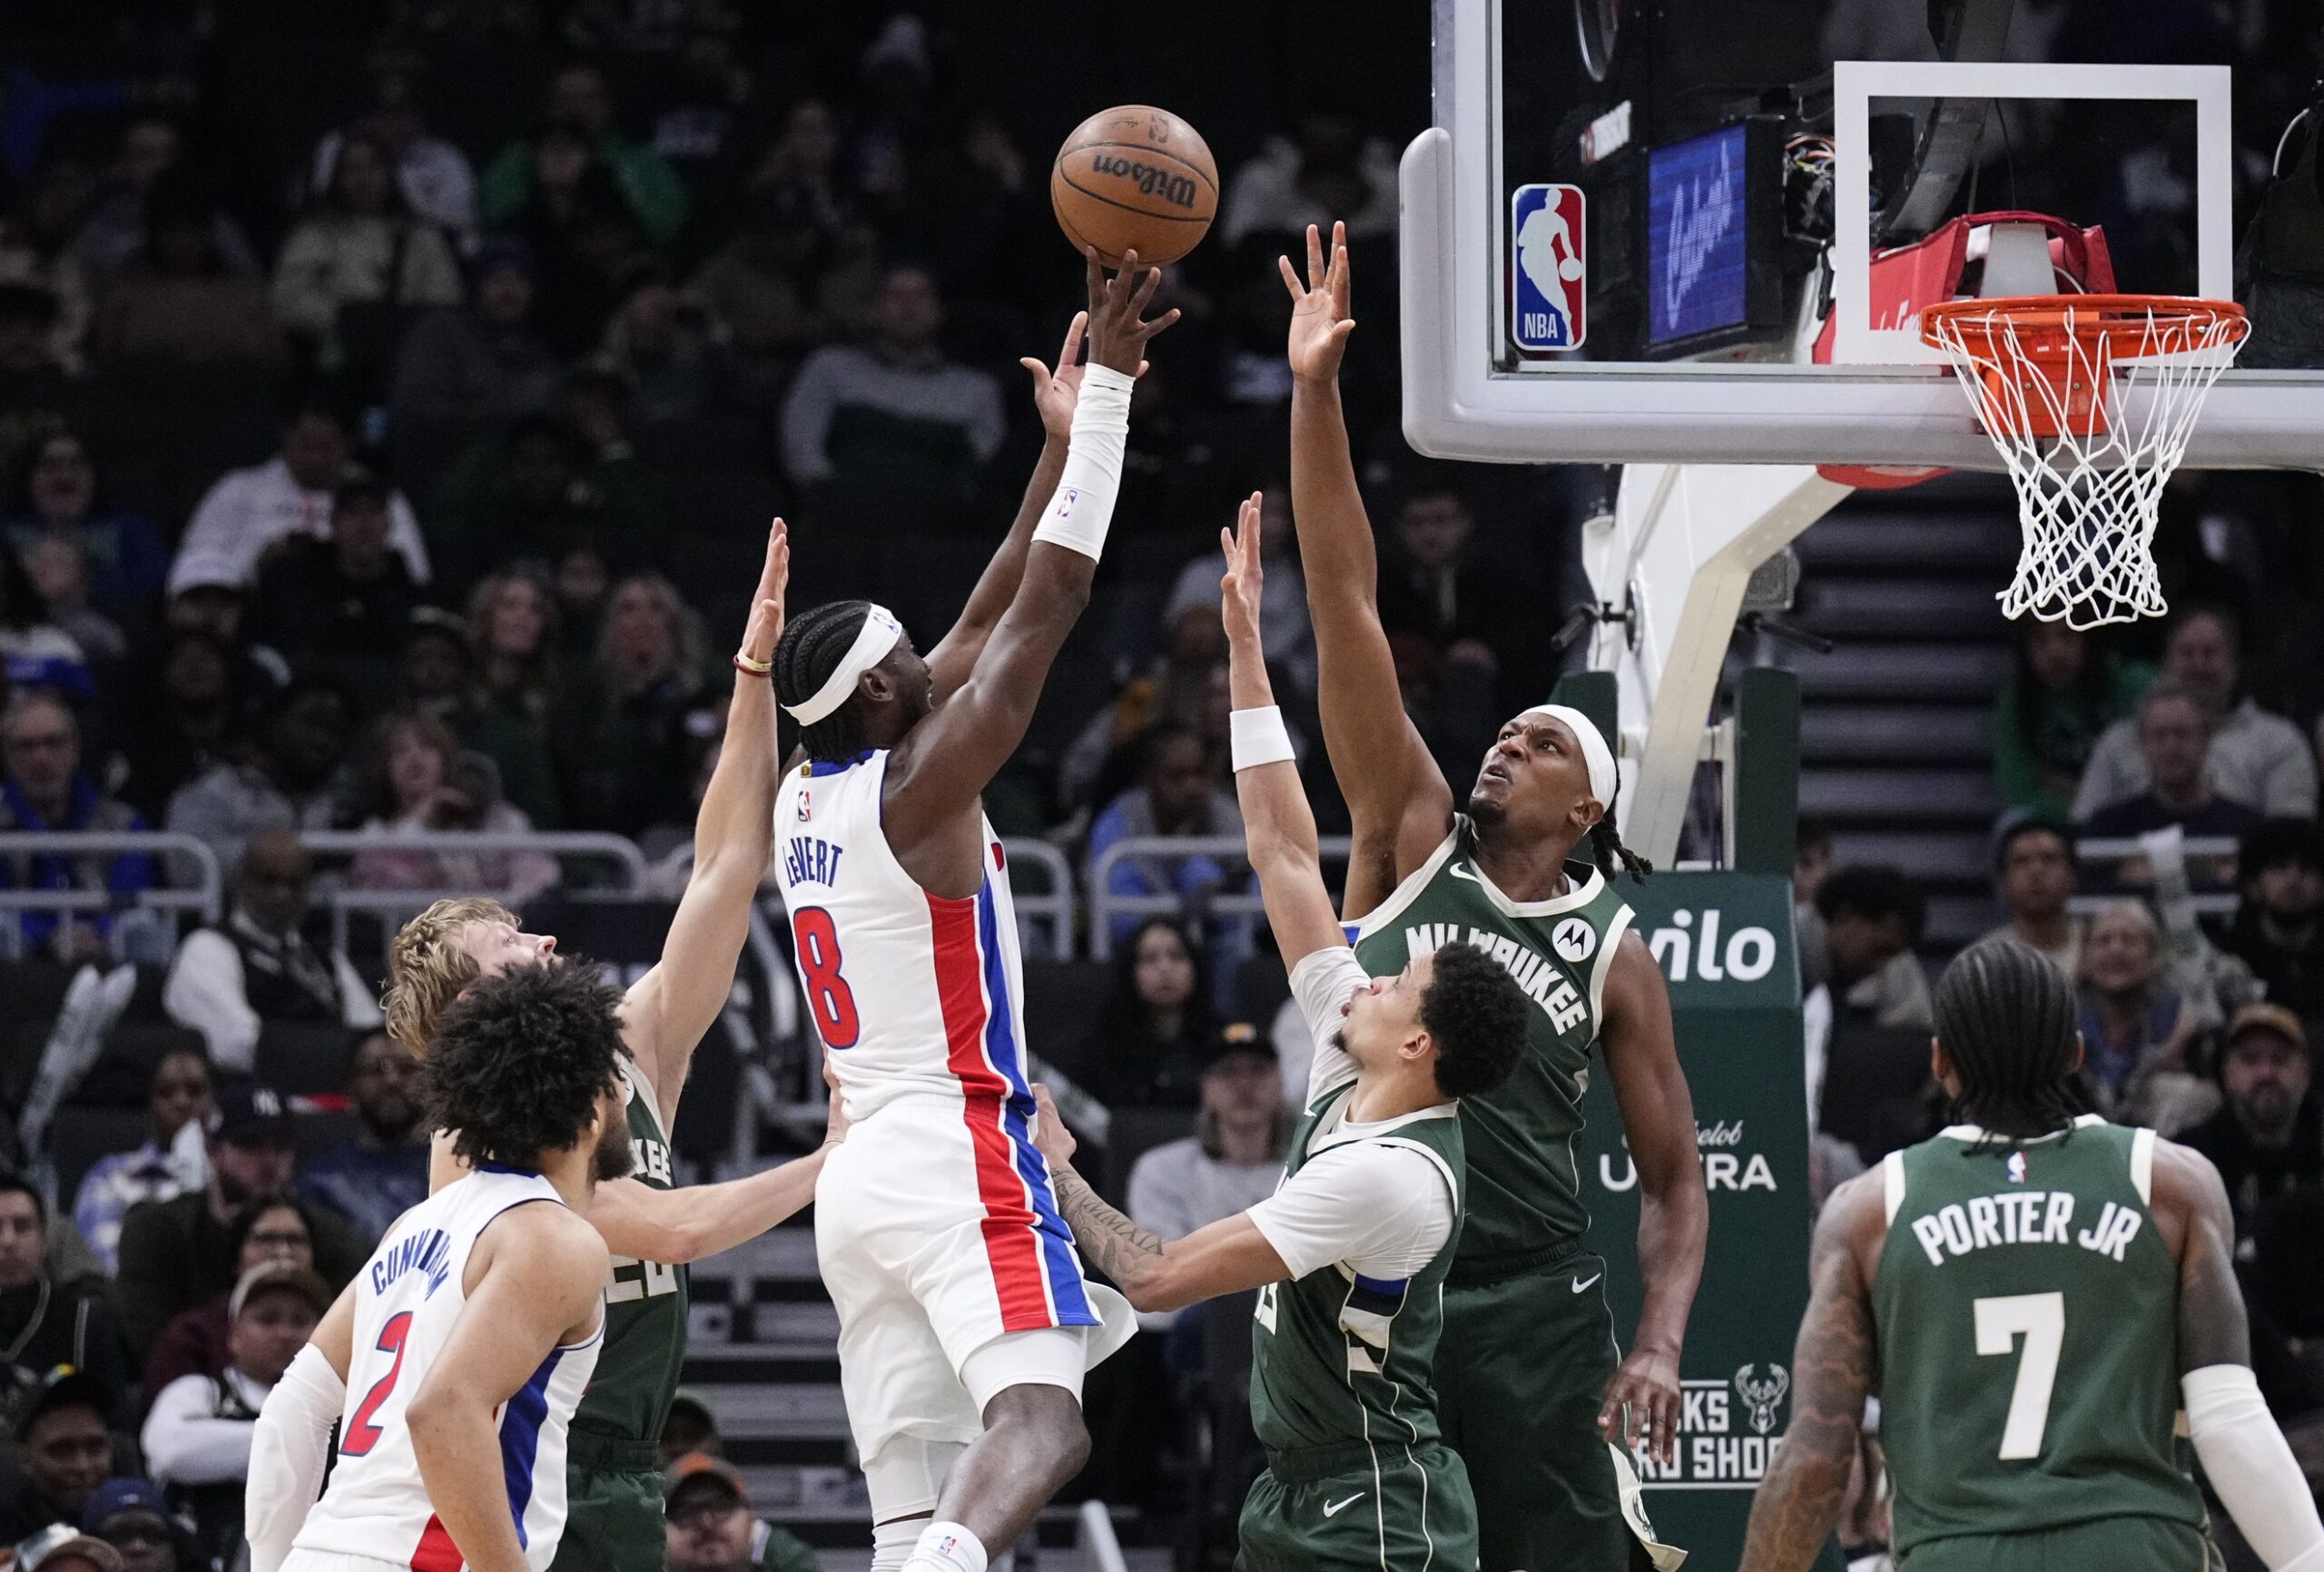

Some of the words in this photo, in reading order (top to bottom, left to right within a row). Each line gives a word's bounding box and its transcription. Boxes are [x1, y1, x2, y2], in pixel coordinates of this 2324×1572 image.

[1092, 154, 1196, 209] Wilson
[1524, 313, 1558, 339] NBA
[793, 905, 861, 1050] 8
[1600, 1154, 1777, 1192] URA
[1911, 1192, 2075, 1267] PORTER
[2078, 1202, 2142, 1263] JR
[339, 1311, 413, 1457] 2
[1974, 1291, 2065, 1461] 7
